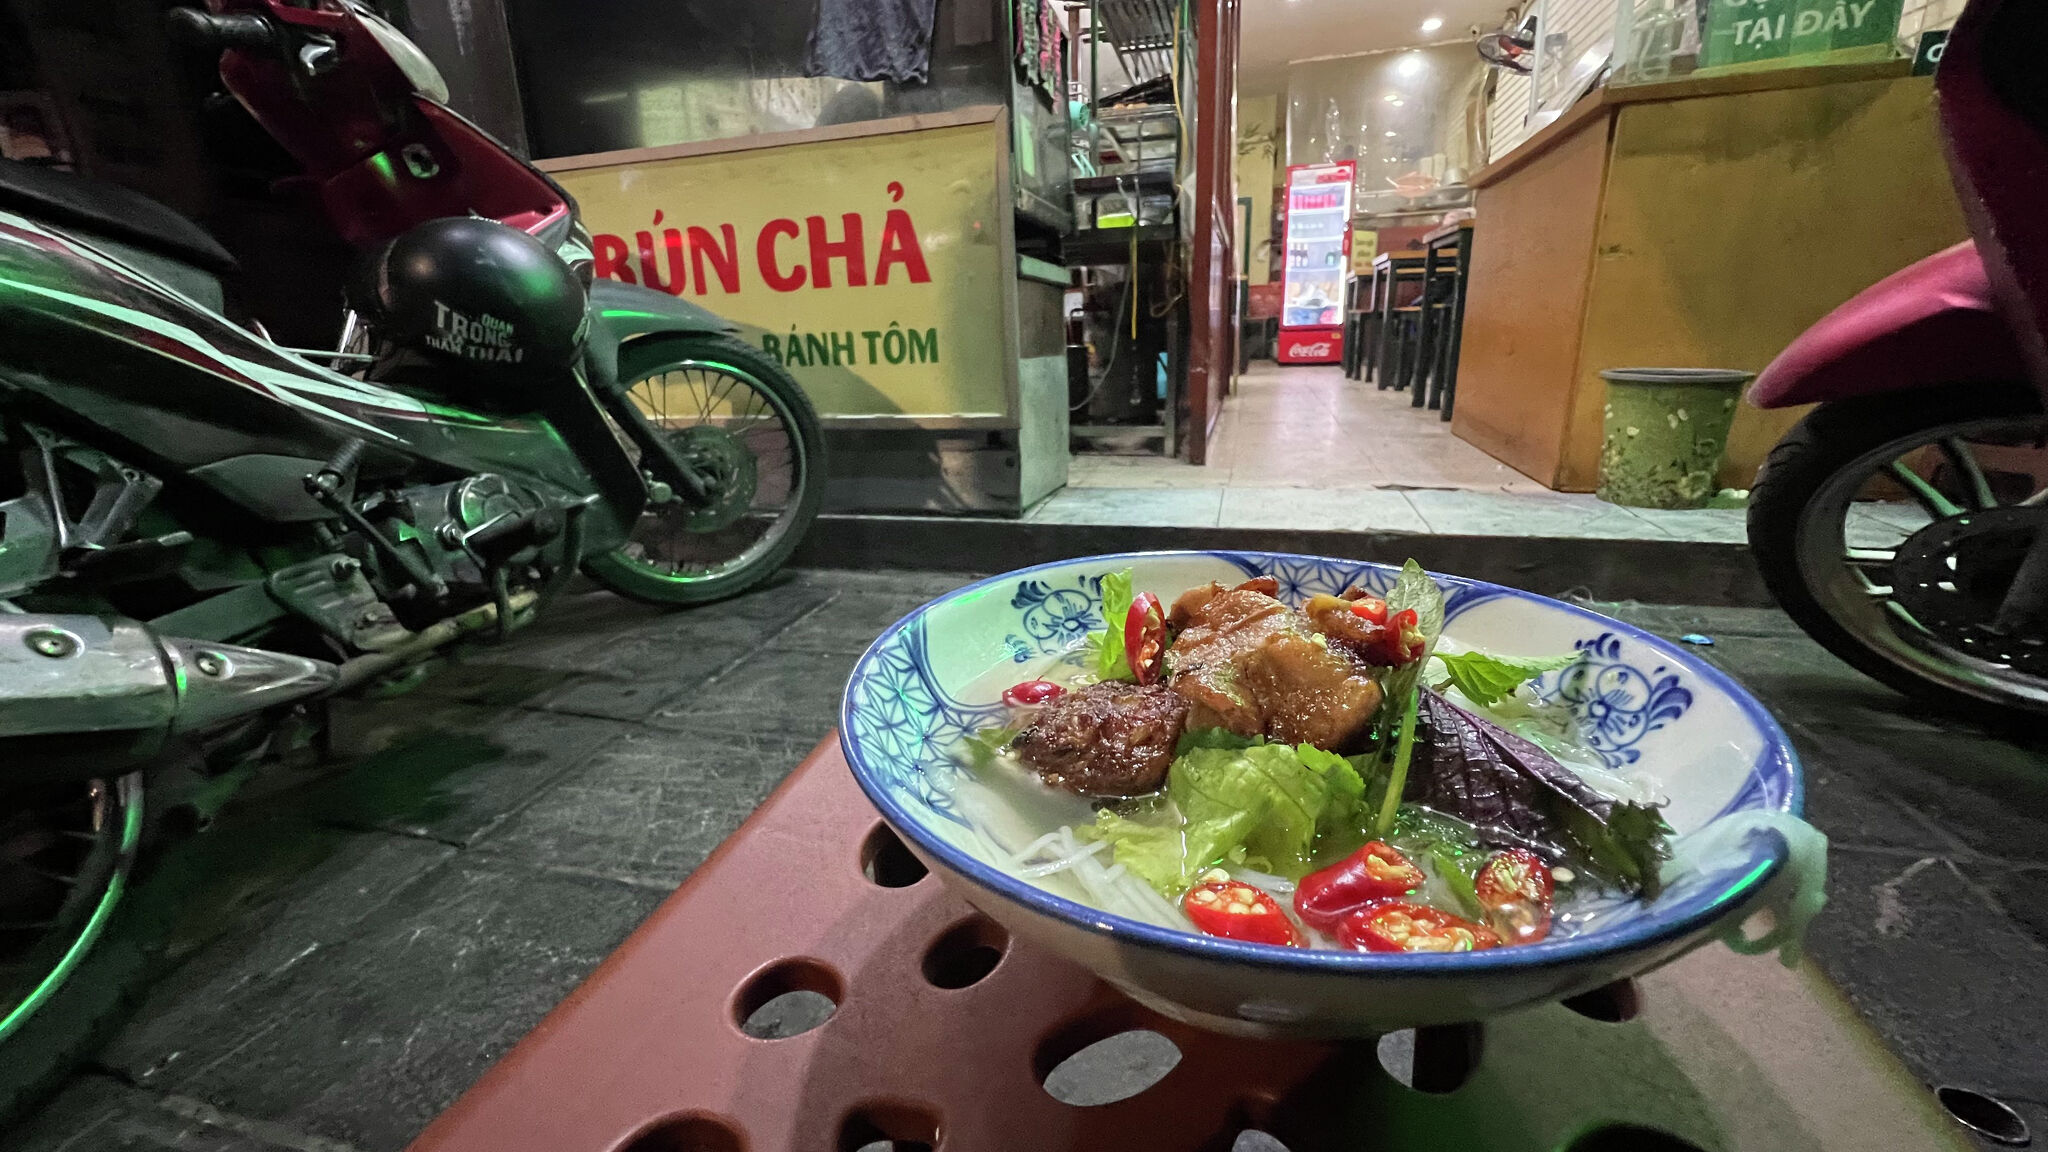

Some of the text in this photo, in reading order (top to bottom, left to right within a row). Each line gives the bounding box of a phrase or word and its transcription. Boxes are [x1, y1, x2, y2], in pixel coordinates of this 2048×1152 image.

[1733, 0, 1876, 50] TẠI ĐÂY
[592, 181, 931, 296] BÚN CHẢ
[762, 320, 939, 367] BÁNH TÔM
